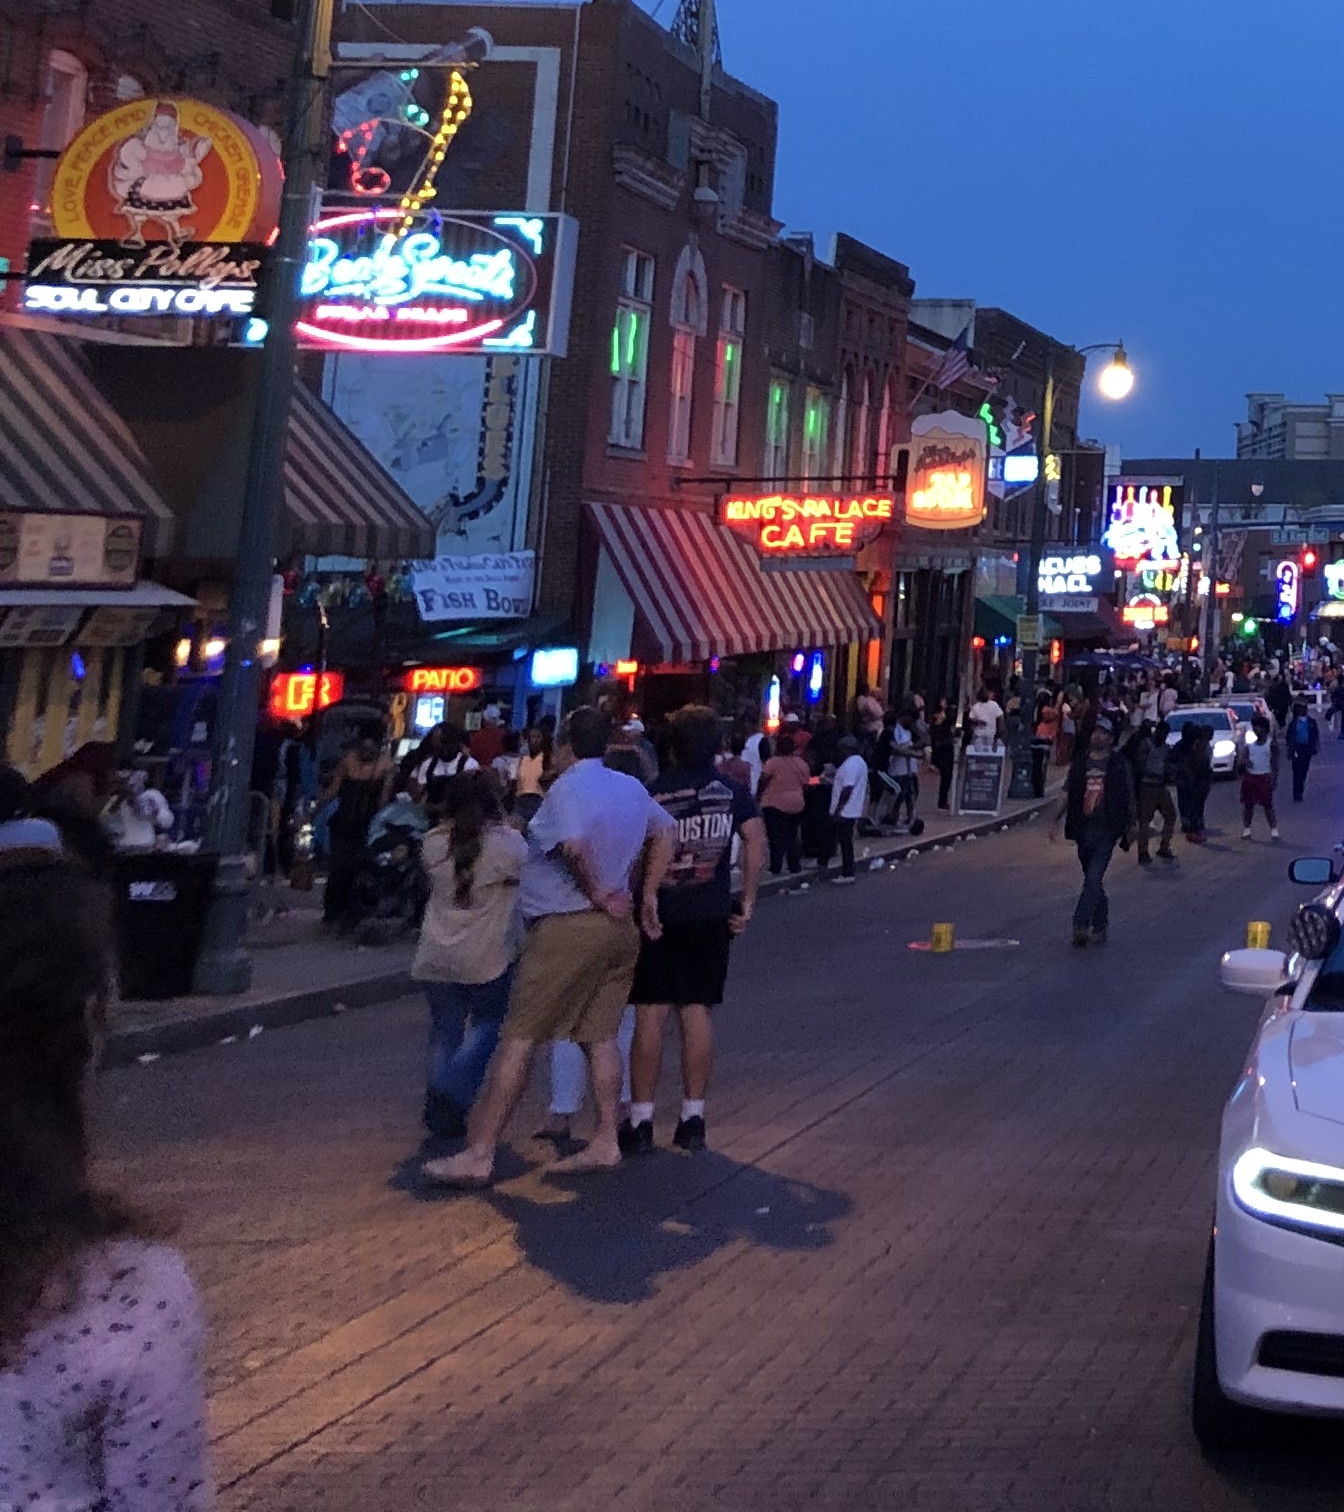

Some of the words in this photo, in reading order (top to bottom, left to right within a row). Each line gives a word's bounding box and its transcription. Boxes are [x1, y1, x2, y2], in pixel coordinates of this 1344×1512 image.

[31, 242, 134, 279] Miss
[800, 498, 892, 521] PALACE
[760, 521, 855, 548] CAFE
[412, 668, 476, 691] PATIO
[679, 813, 734, 844] USTON
